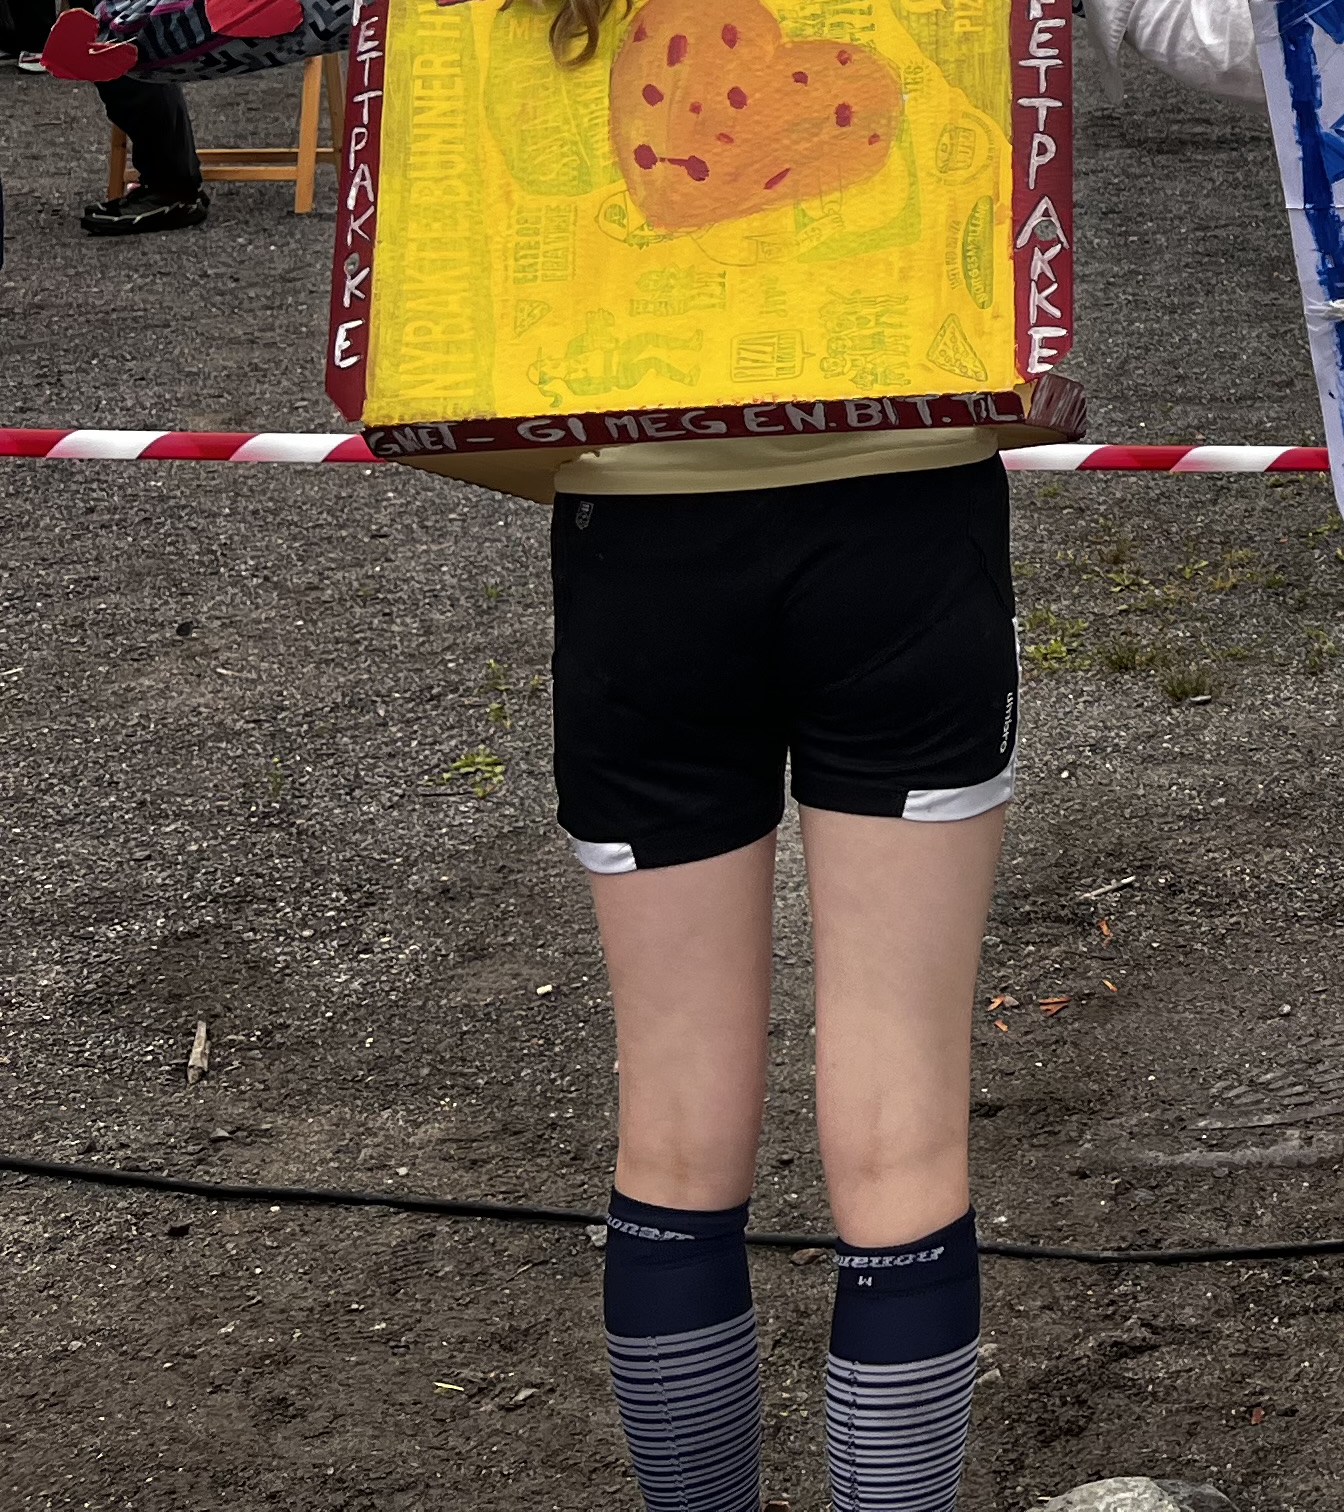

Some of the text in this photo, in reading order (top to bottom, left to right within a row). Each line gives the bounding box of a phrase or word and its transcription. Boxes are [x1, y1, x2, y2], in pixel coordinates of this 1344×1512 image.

[411, 54, 470, 204] BUNNER
[516, 417, 587, 442] GI
[605, 411, 727, 441] MEG
[1000, 692, 1014, 754] umbro
